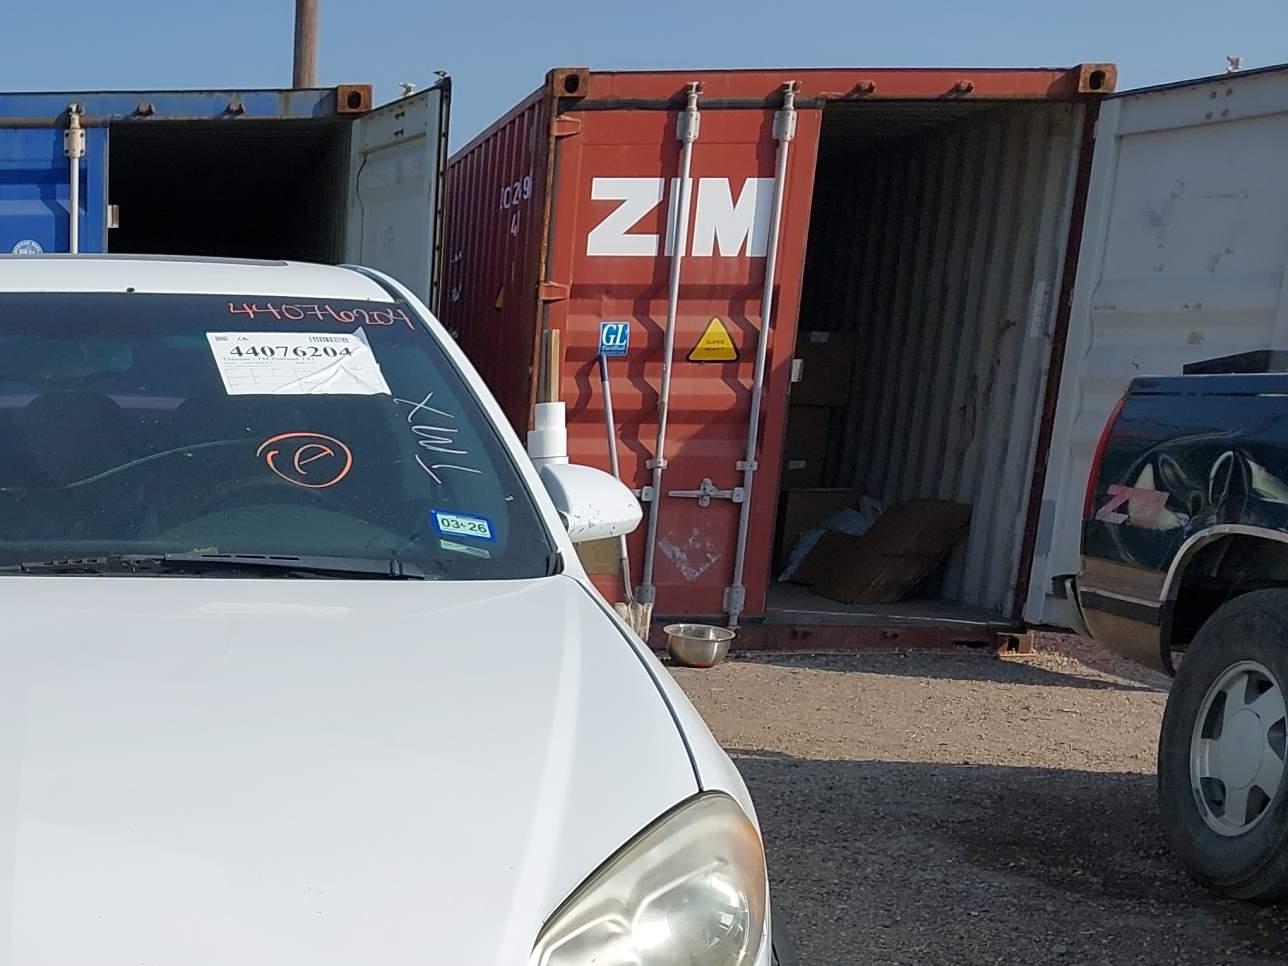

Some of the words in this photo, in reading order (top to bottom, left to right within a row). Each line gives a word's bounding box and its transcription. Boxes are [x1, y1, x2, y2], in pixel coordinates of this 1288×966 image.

[587, 177, 776, 257] ZIM
[228, 302, 415, 330] 44076204
[602, 323, 628, 346] GL
[229, 345, 353, 358] 44076204
